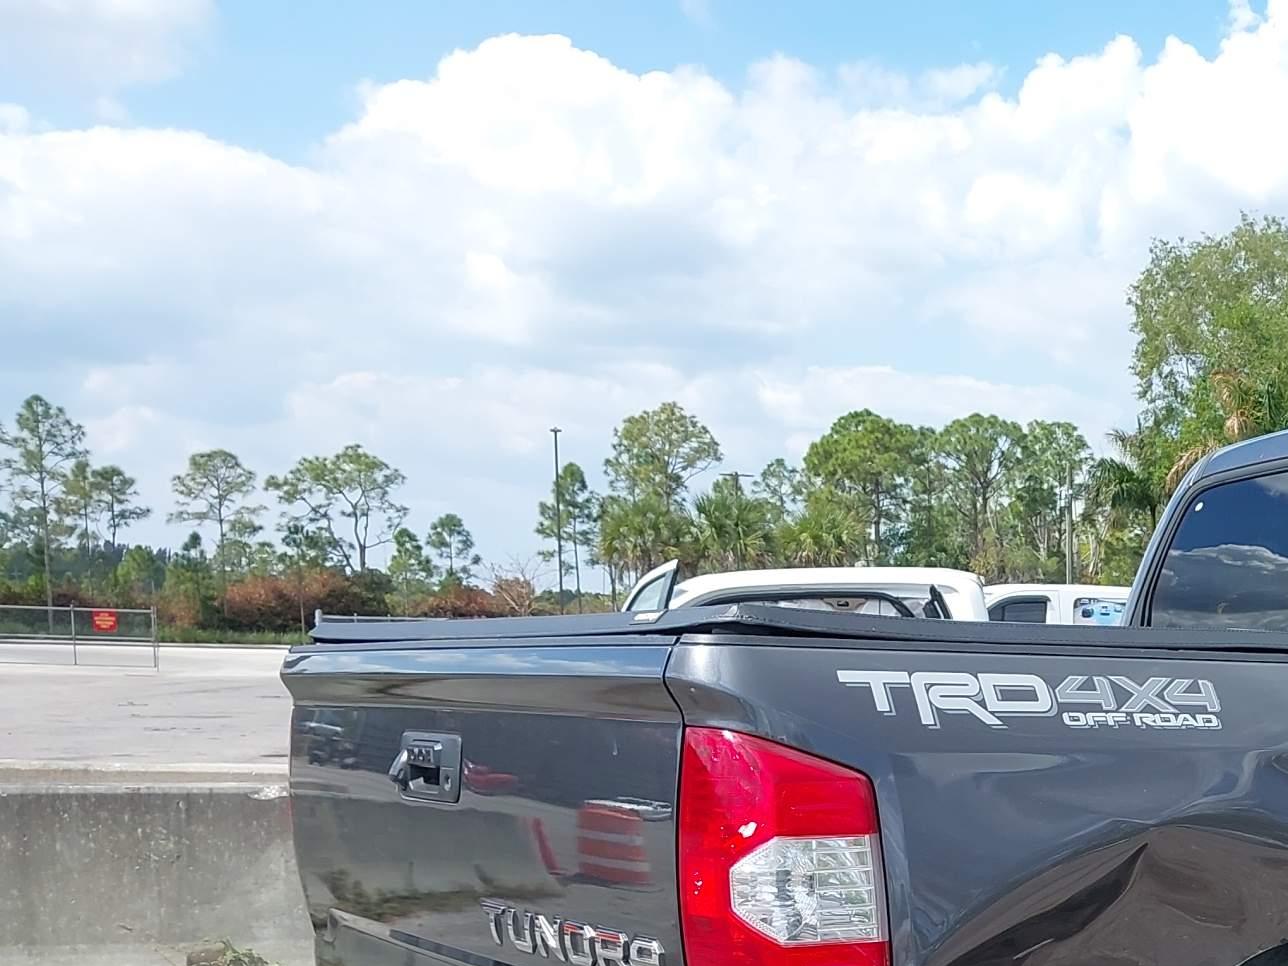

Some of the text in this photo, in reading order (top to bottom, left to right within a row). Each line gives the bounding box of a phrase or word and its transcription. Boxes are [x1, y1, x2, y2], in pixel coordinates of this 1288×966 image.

[836, 669, 1222, 730] TRD 4X4
[1062, 711, 1223, 731] OFF ROAD
